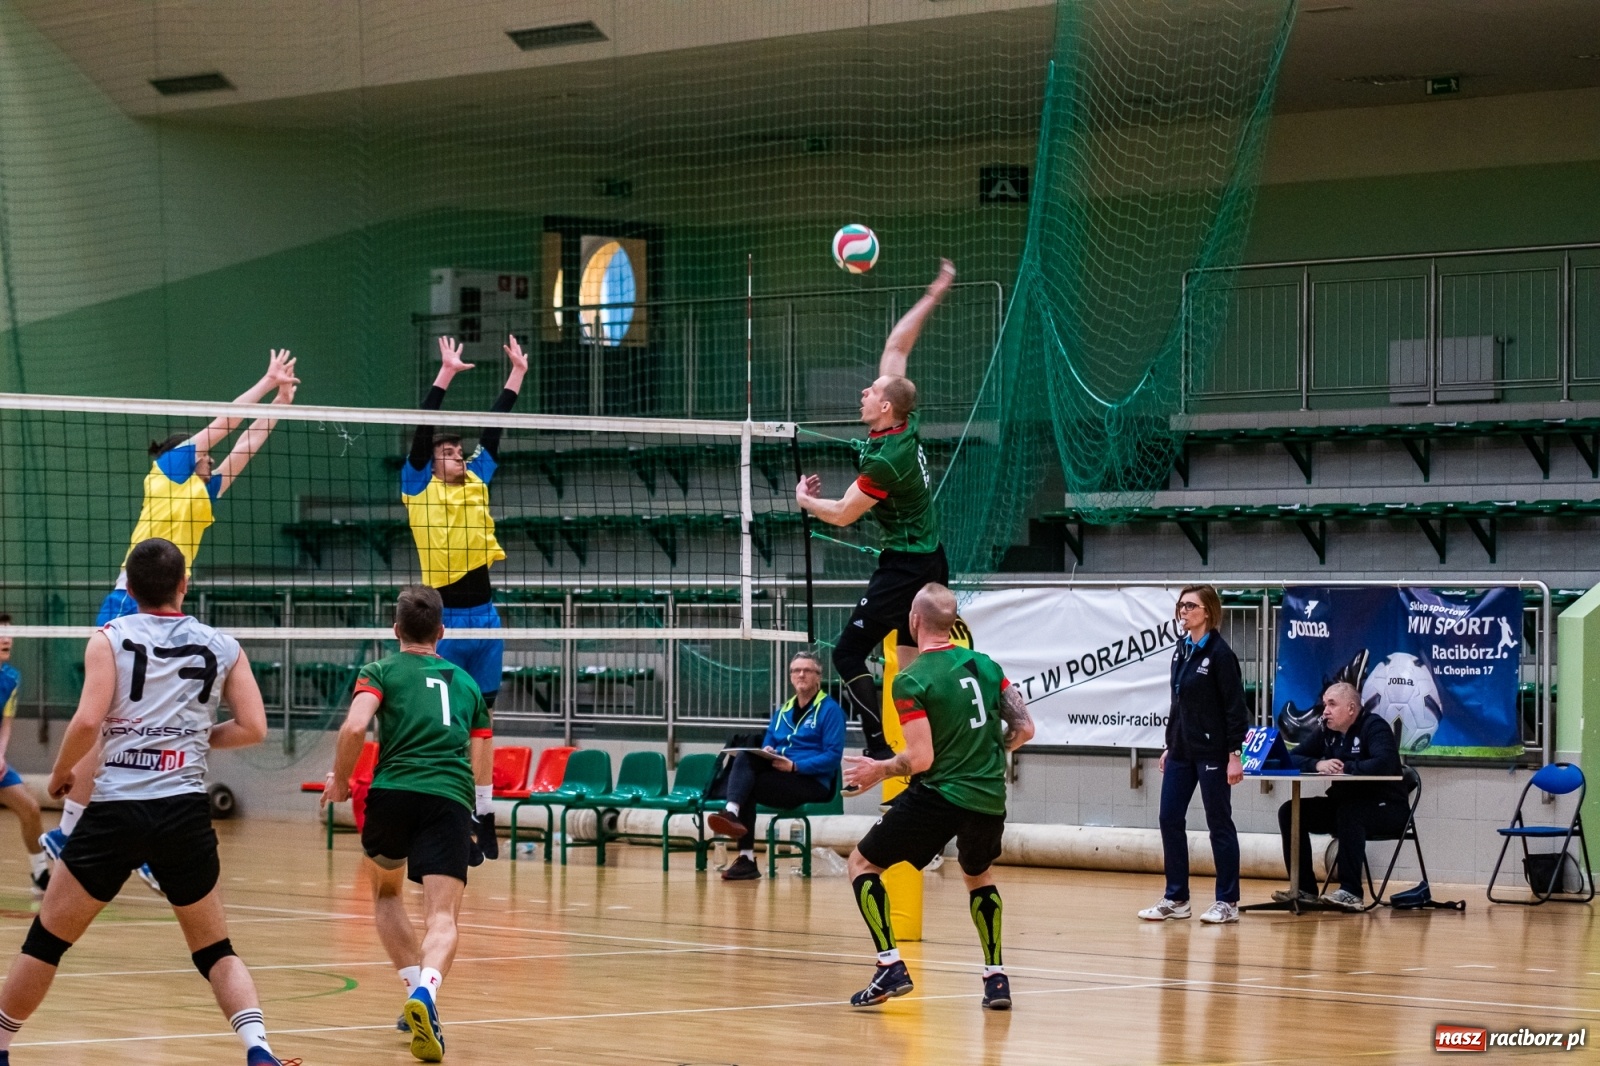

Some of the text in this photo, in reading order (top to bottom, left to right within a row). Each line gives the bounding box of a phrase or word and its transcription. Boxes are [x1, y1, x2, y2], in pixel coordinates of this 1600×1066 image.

[989, 180, 1019, 198] A
[1409, 602, 1428, 613] Sklep
[1407, 616, 1494, 635] MW SPORT
[1432, 643, 1494, 660] Racibórz
[1040, 665, 1061, 693] W
[1433, 665, 1494, 677] ul. Chopina 17
[426, 677, 451, 727] 7
[959, 676, 987, 729] 3
[1248, 732, 1267, 753] 13
